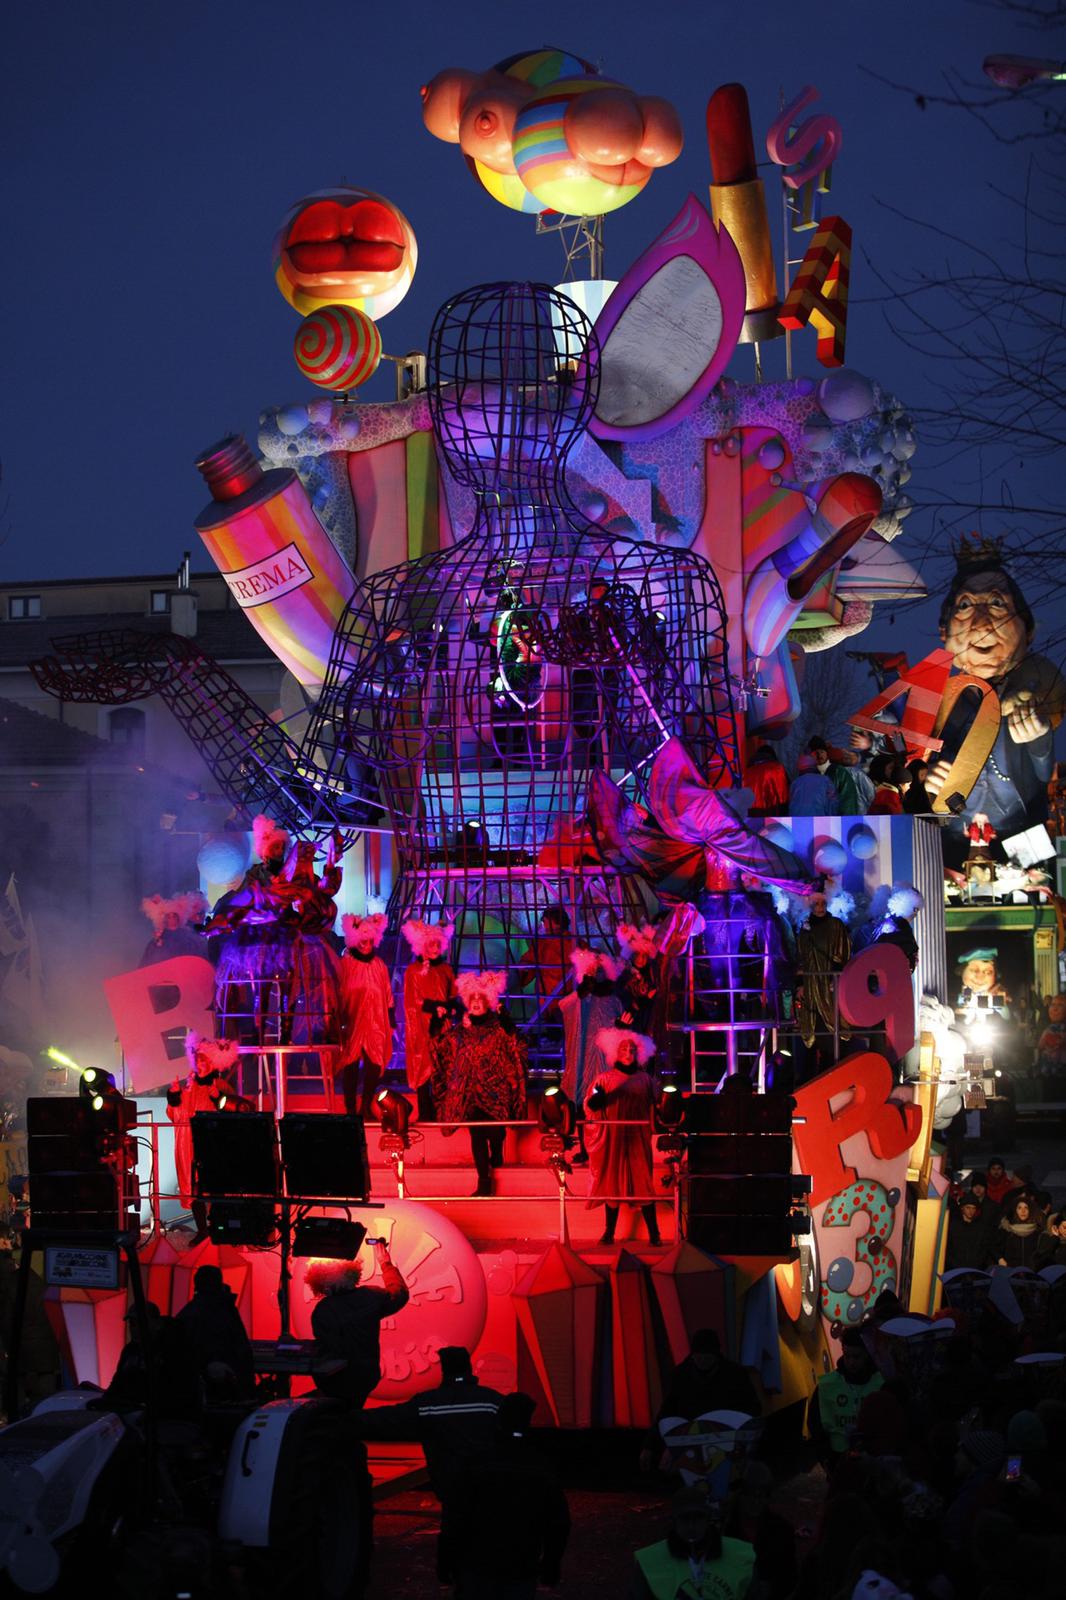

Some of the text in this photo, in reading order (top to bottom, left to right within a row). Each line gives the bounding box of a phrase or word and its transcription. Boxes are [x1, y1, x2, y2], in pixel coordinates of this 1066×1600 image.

[776, 216, 853, 368] A
[103, 955, 216, 1095] B
[790, 1050, 923, 1208] R
